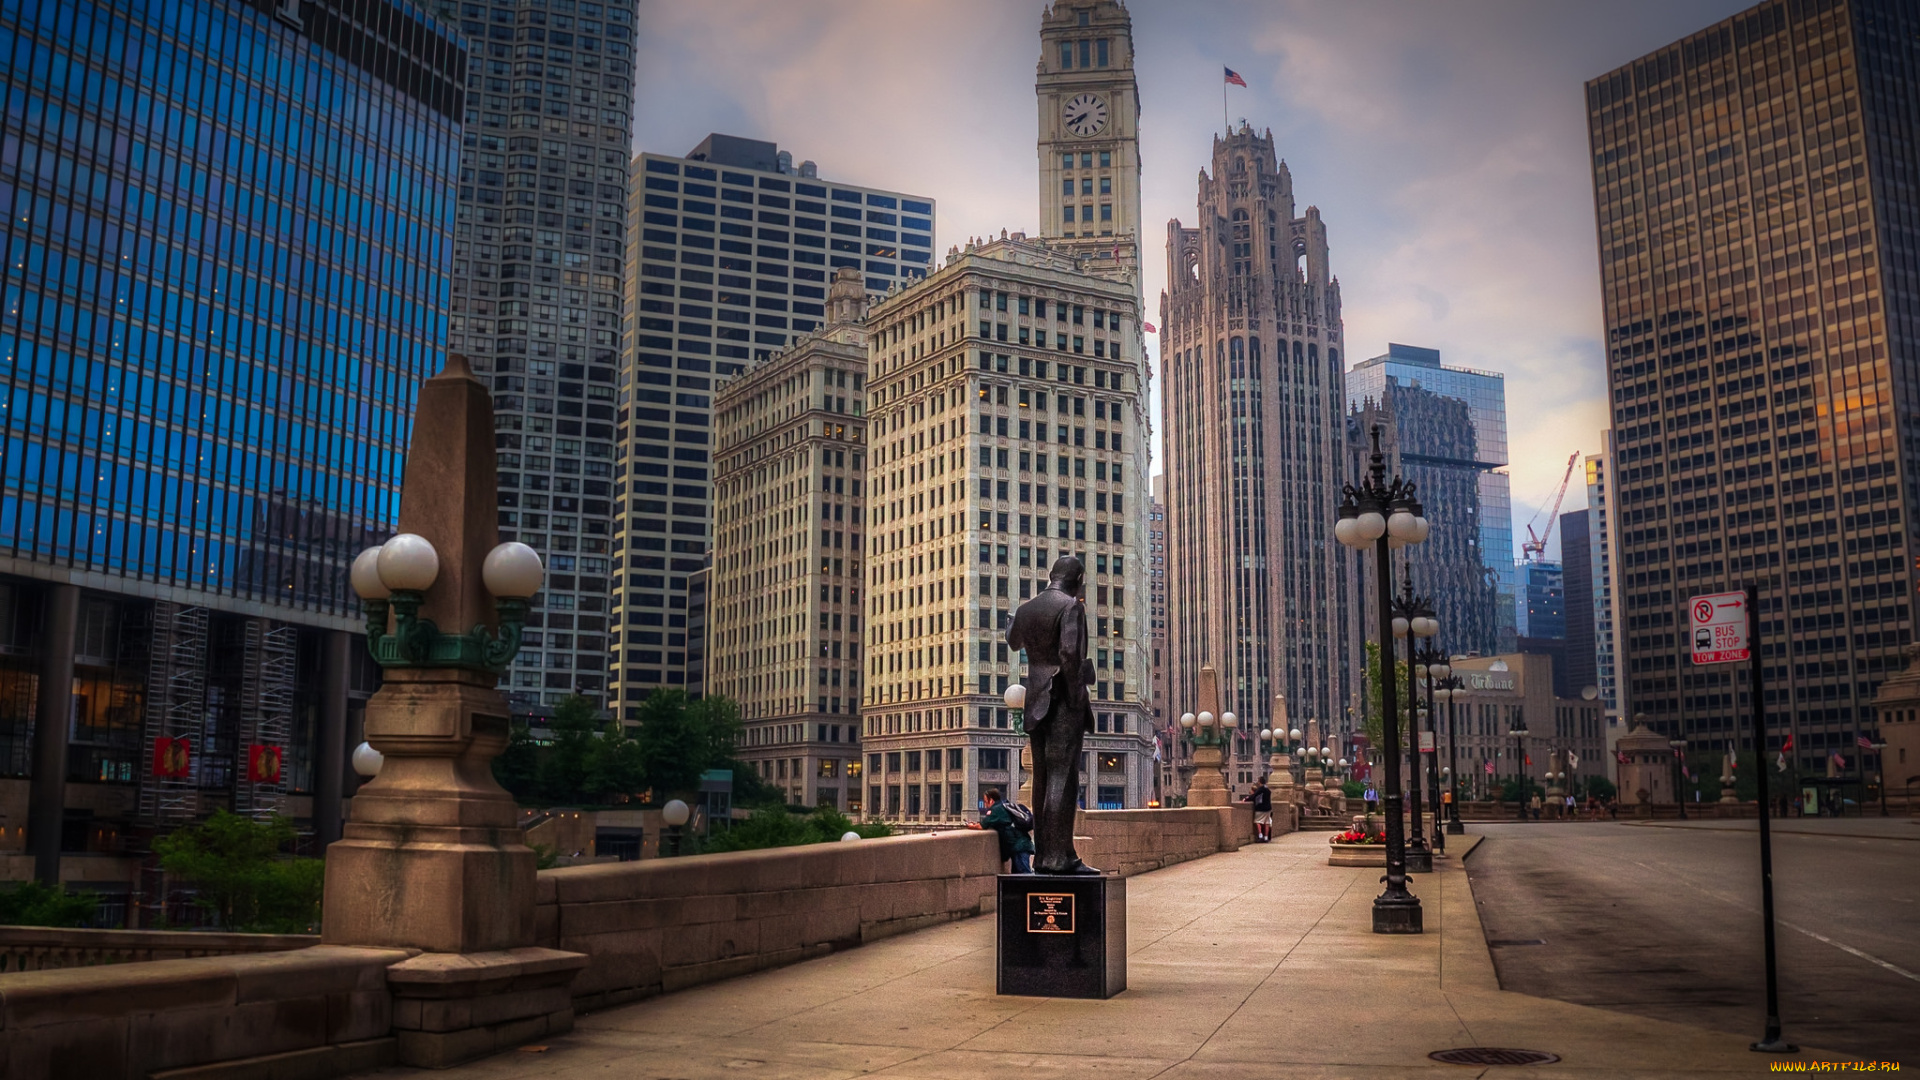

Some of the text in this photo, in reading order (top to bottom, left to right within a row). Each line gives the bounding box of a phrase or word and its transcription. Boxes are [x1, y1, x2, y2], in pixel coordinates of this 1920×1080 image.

[1715, 625, 1735, 637] BUS
[1715, 636, 1740, 649] STOP
[1696, 649, 1744, 662] TOW ZONE
[1470, 673, 1515, 690] Tribune
